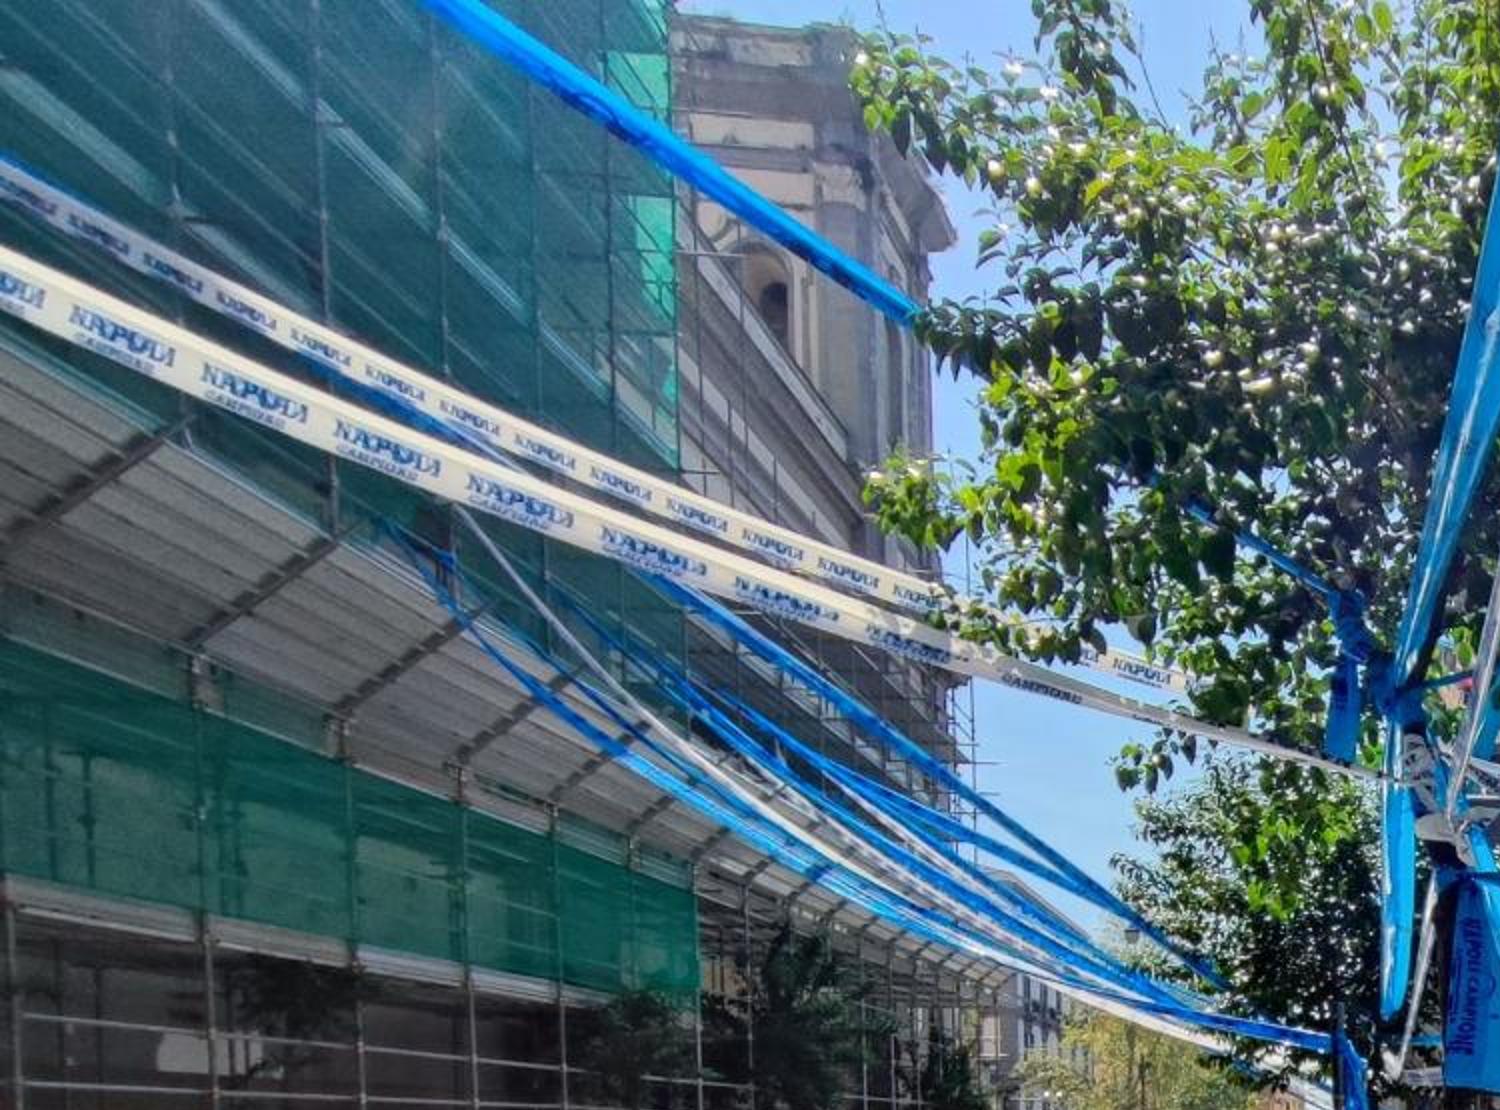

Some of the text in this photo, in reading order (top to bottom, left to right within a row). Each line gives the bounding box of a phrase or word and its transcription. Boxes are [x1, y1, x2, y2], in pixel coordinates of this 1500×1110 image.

[67, 304, 177, 368] NAPOLI
[201, 362, 308, 425] NAPOLI
[334, 417, 441, 478] NAPOLI
[465, 472, 575, 529] NAPOLI
[600, 526, 708, 577] NAPOLI
[1113, 656, 1172, 686] NAPOLI
